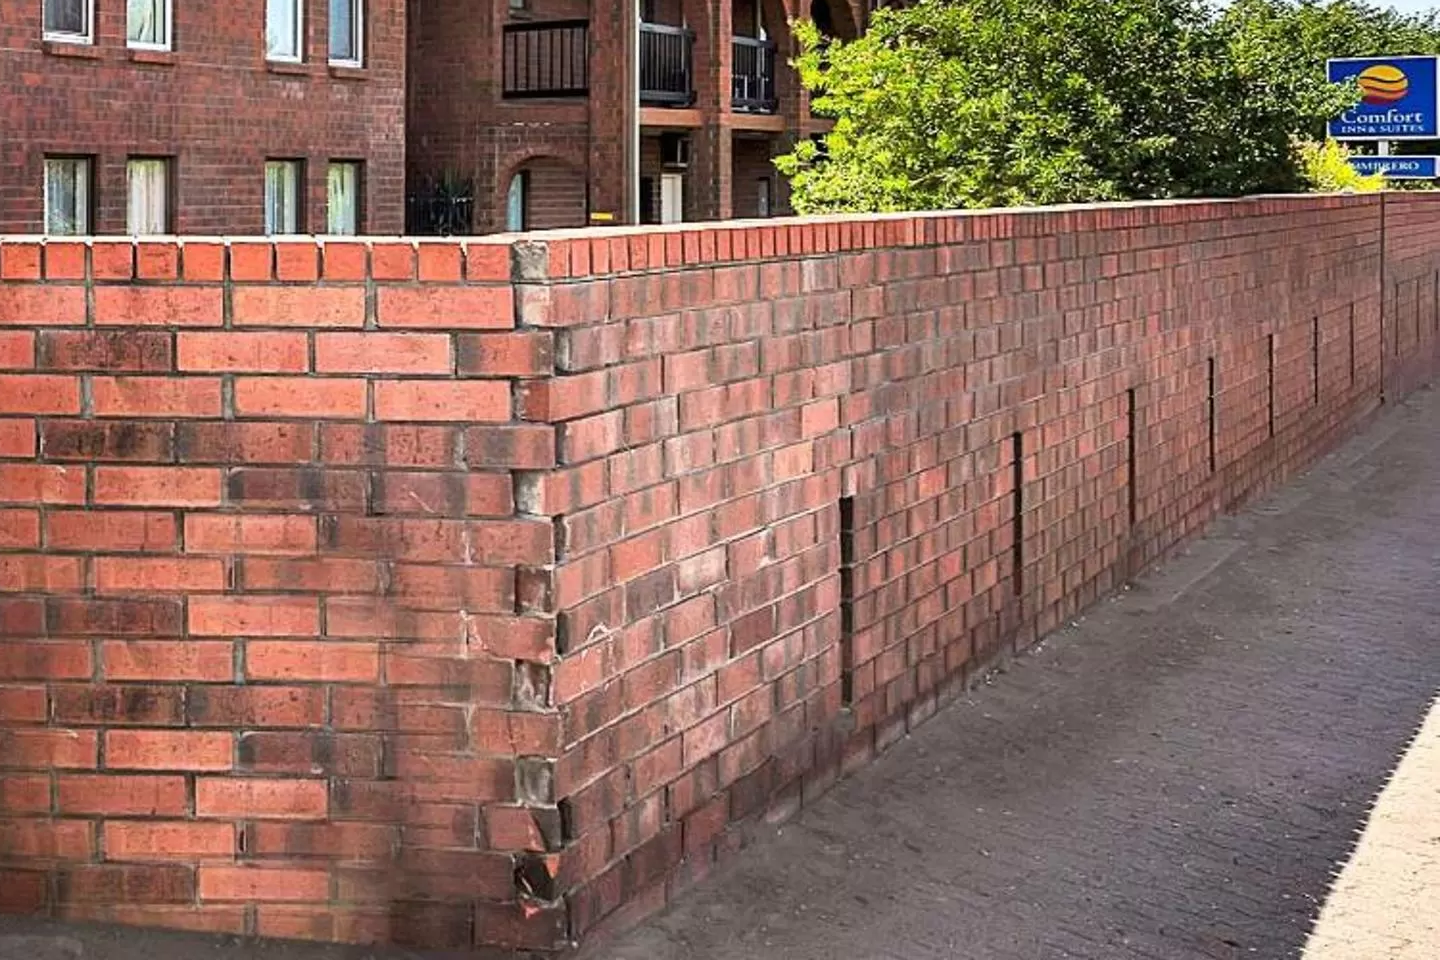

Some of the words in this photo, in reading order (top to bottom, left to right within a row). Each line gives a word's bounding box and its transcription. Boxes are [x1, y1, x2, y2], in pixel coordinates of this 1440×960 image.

[1341, 108, 1424, 124] Comfort
[1341, 125, 1366, 133] INN
[1380, 124, 1425, 133] SUITES
